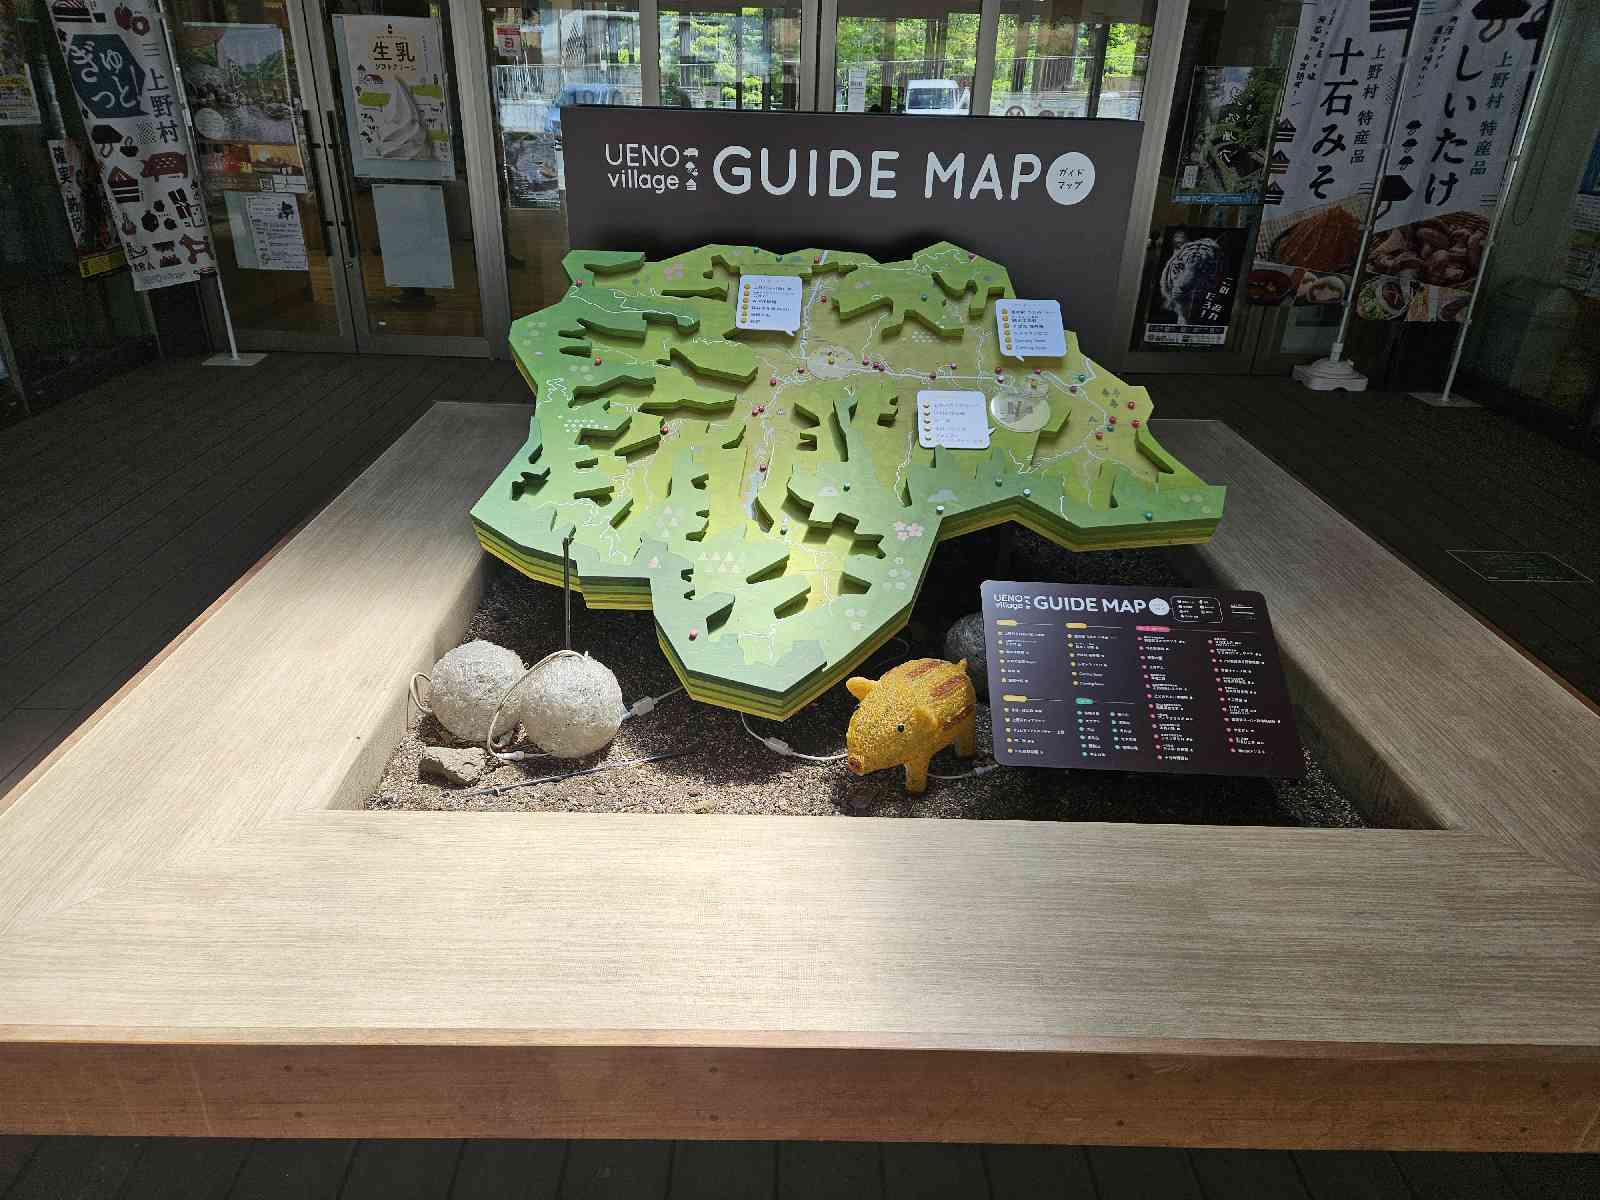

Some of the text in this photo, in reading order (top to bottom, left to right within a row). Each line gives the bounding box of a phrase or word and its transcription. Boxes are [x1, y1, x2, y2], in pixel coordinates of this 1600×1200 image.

[372, 41, 415, 62] 生乳
[148, 67, 179, 144] 上野村
[1309, 37, 1365, 199] 十石みそ
[1350, 43, 1385, 164] 上野村 特産品
[1425, 44, 1483, 206] しいたけ
[1470, 50, 1513, 176] 上野村 特産品
[605, 143, 680, 167] UENO
[607, 169, 680, 194] village
[712, 145, 1042, 201] GUIDE MAP
[993, 593, 1023, 603] UENO
[1033, 595, 1099, 612] GUIDE
[1101, 598, 1147, 614] MAP
